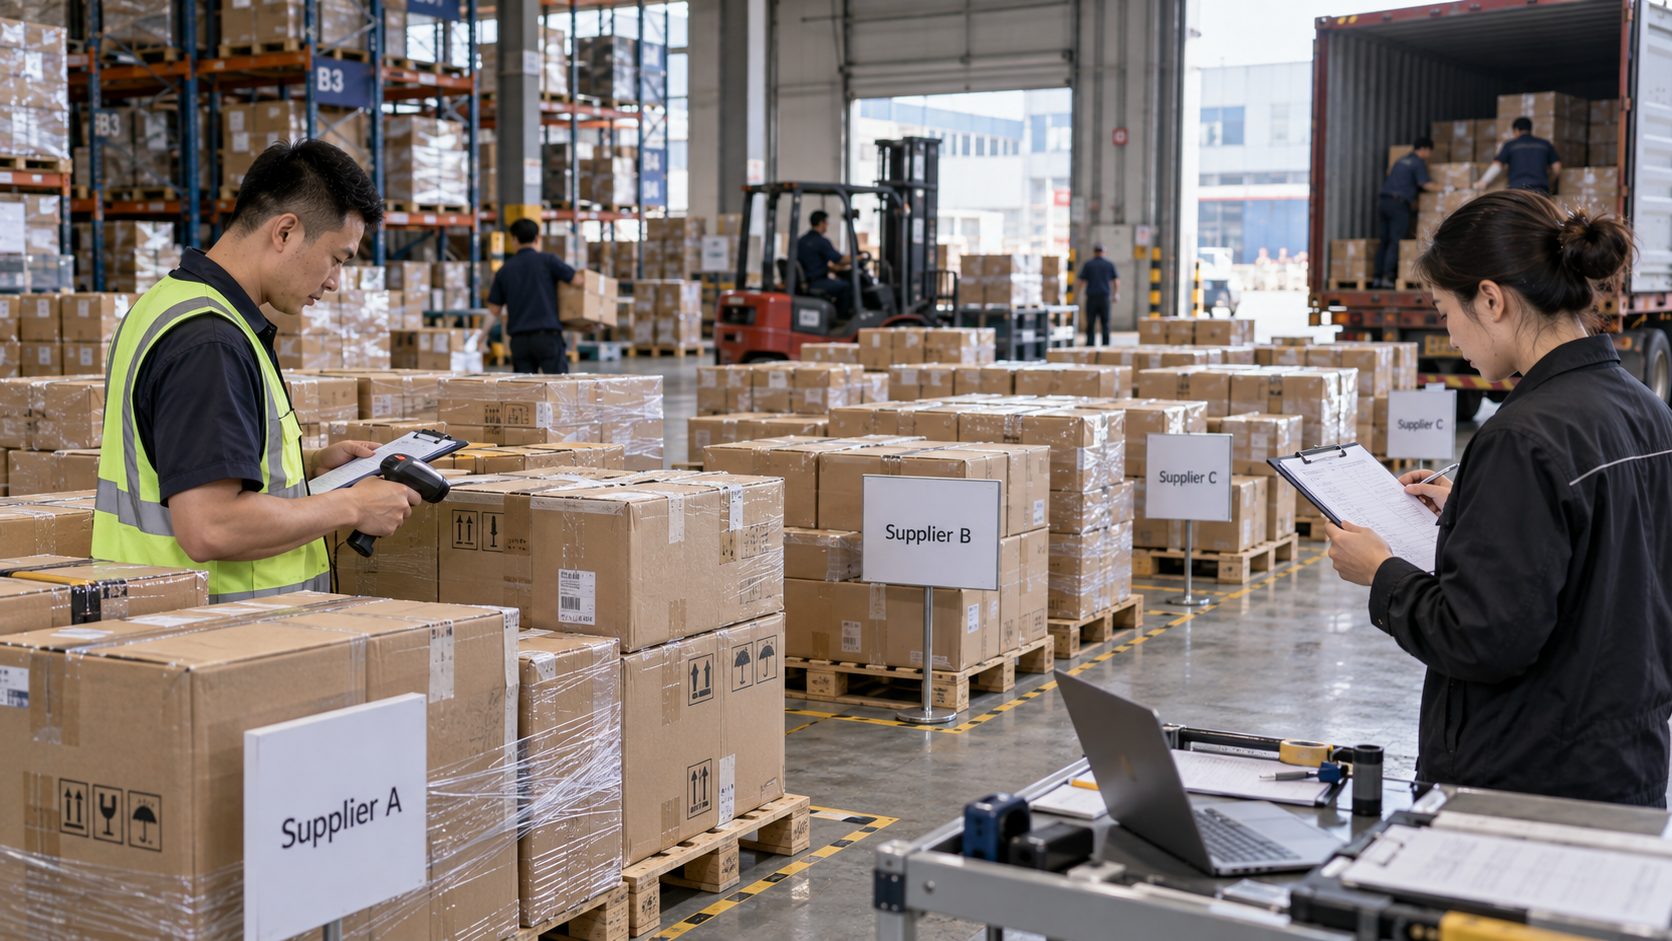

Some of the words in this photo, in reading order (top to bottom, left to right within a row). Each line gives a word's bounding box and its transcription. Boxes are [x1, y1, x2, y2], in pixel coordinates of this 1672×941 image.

[317, 67, 344, 93] B3
[1397, 418, 1434, 433] Supplier
[1435, 419, 1444, 431] C
[1158, 470, 1206, 488] Supplier
[1208, 470, 1217, 485] C
[885, 523, 954, 546] Supplier
[959, 528, 972, 544] B
[281, 797, 379, 850] Supplier
[385, 786, 403, 817] A
